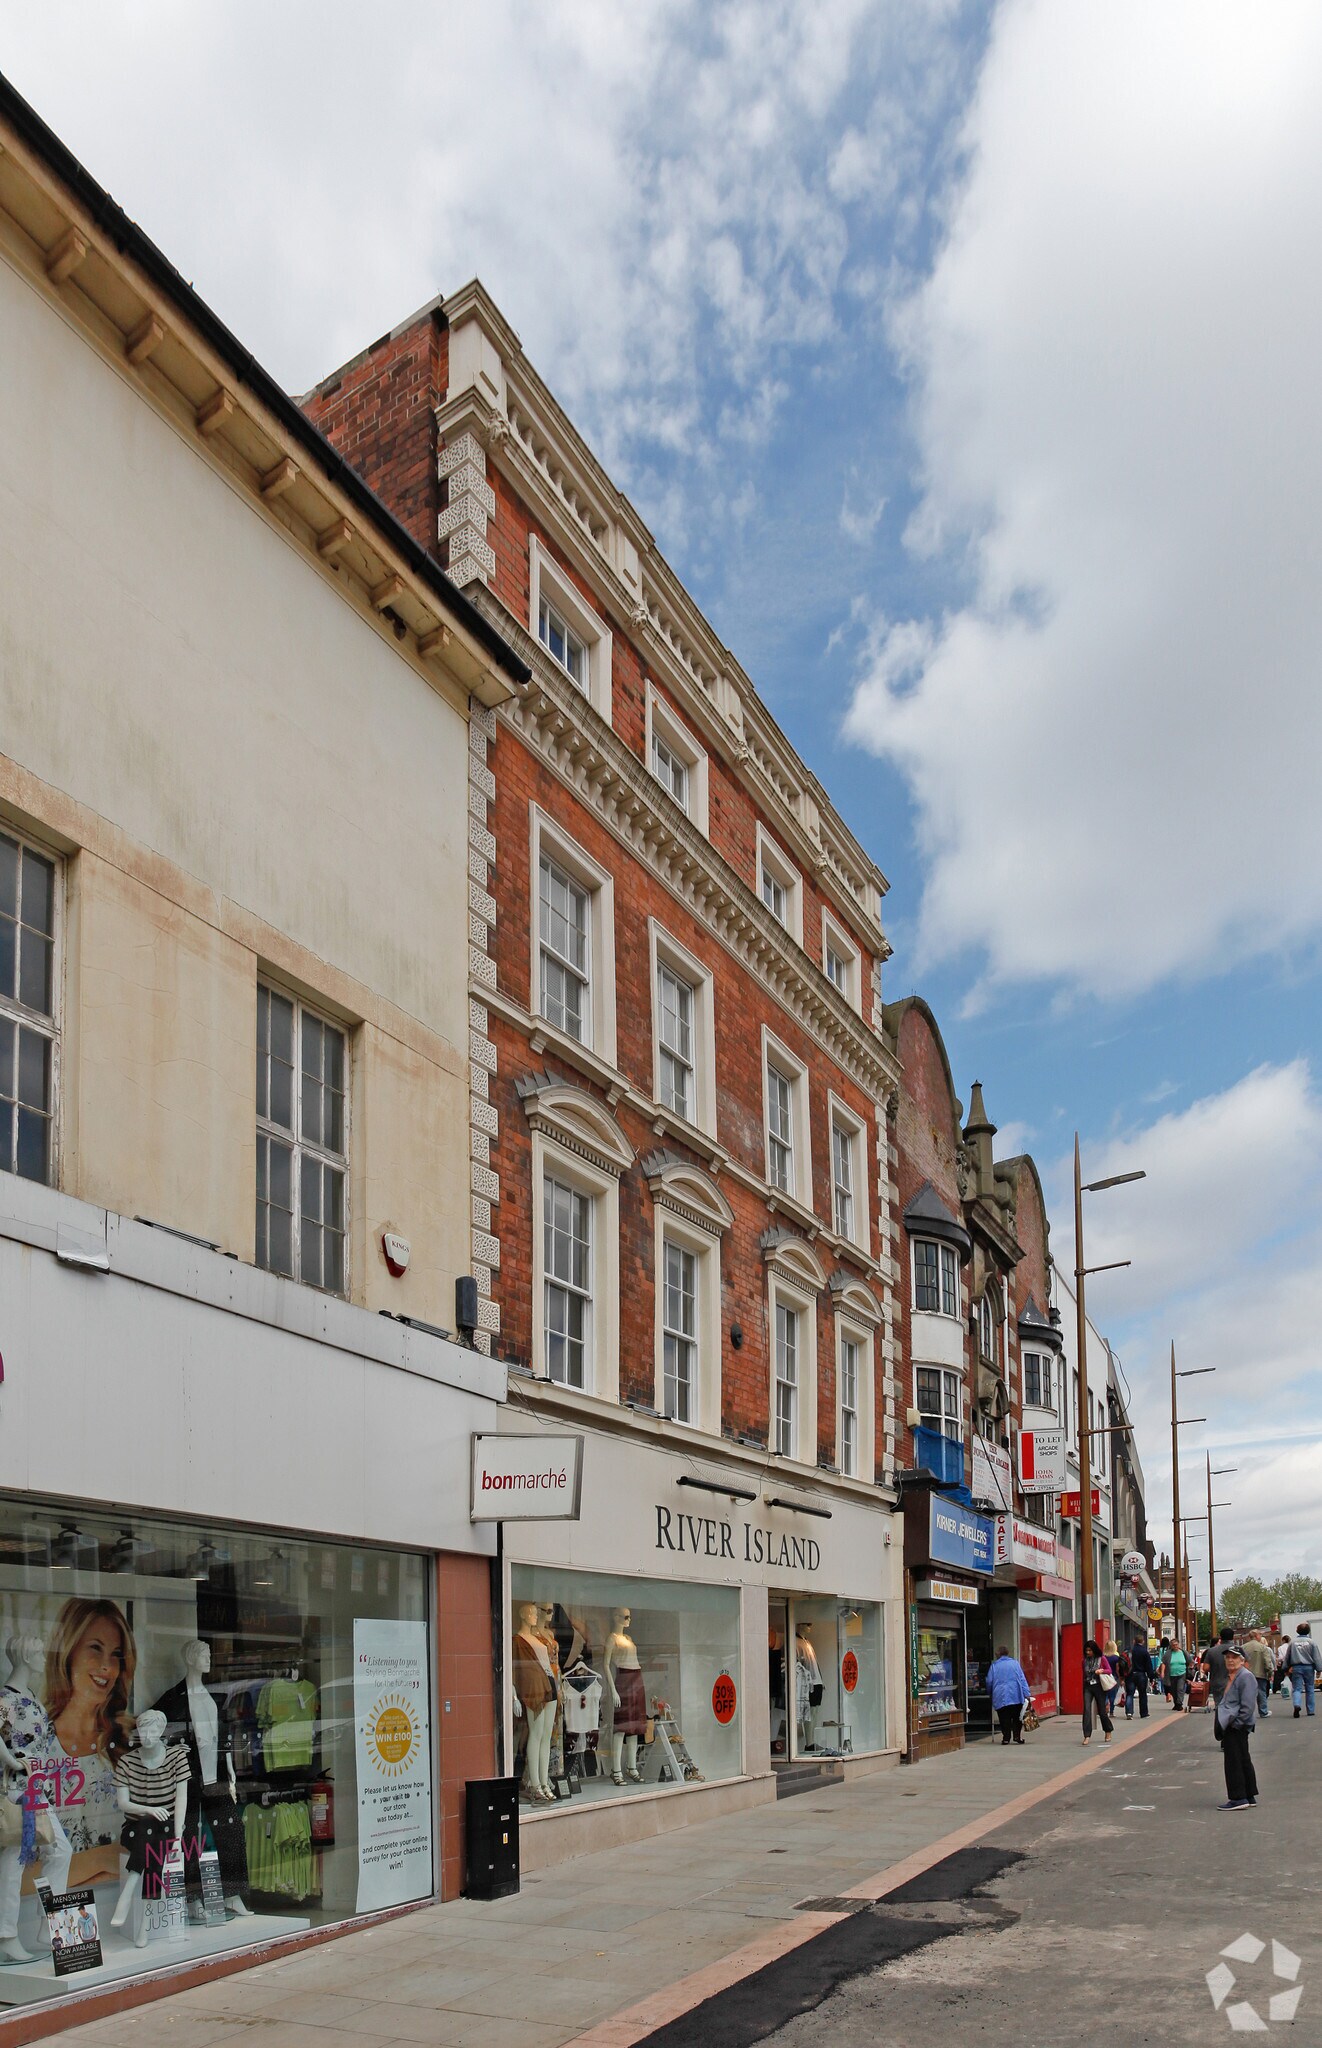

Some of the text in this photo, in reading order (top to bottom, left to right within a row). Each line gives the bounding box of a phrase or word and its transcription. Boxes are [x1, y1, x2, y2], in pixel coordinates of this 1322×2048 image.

[391, 1240, 410, 1253] KINGS
[481, 1467, 567, 1491] bonmarché
[936, 1513, 987, 1546] KIRNER JEWELLERS
[997, 1515, 1006, 1554] CAFE
[654, 1504, 821, 1571] RIVER ISLAND
[1123, 1563, 1144, 1571] HSBC
[365, 1668, 387, 1677] Styling
[715, 1685, 734, 1699] 30%
[715, 1699, 734, 1713] OFF
[375, 1731, 412, 1743] WIN £100
[30, 1756, 79, 1773] BLOUSE
[24, 1769, 87, 1811] £12
[364, 1787, 382, 1795] Please
[382, 1785, 390, 1793] let
[392, 1803, 407, 1811] store
[387, 1813, 403, 1821] today
[145, 1833, 207, 1868] NEW
[362, 1835, 428, 1854] and complete your online
[362, 1855, 380, 1864] survey
[380, 1852, 389, 1860] for
[389, 1850, 403, 1859] your
[402, 1847, 421, 1855] chance
[388, 1859, 404, 1870] win!
[145, 1869, 171, 1899] IN
[52, 1891, 89, 1904] MENSWEAR
[144, 1903, 154, 1917] &
[145, 1912, 177, 1932] JUST
[55, 1941, 98, 1957] NOW AVAILABLE
